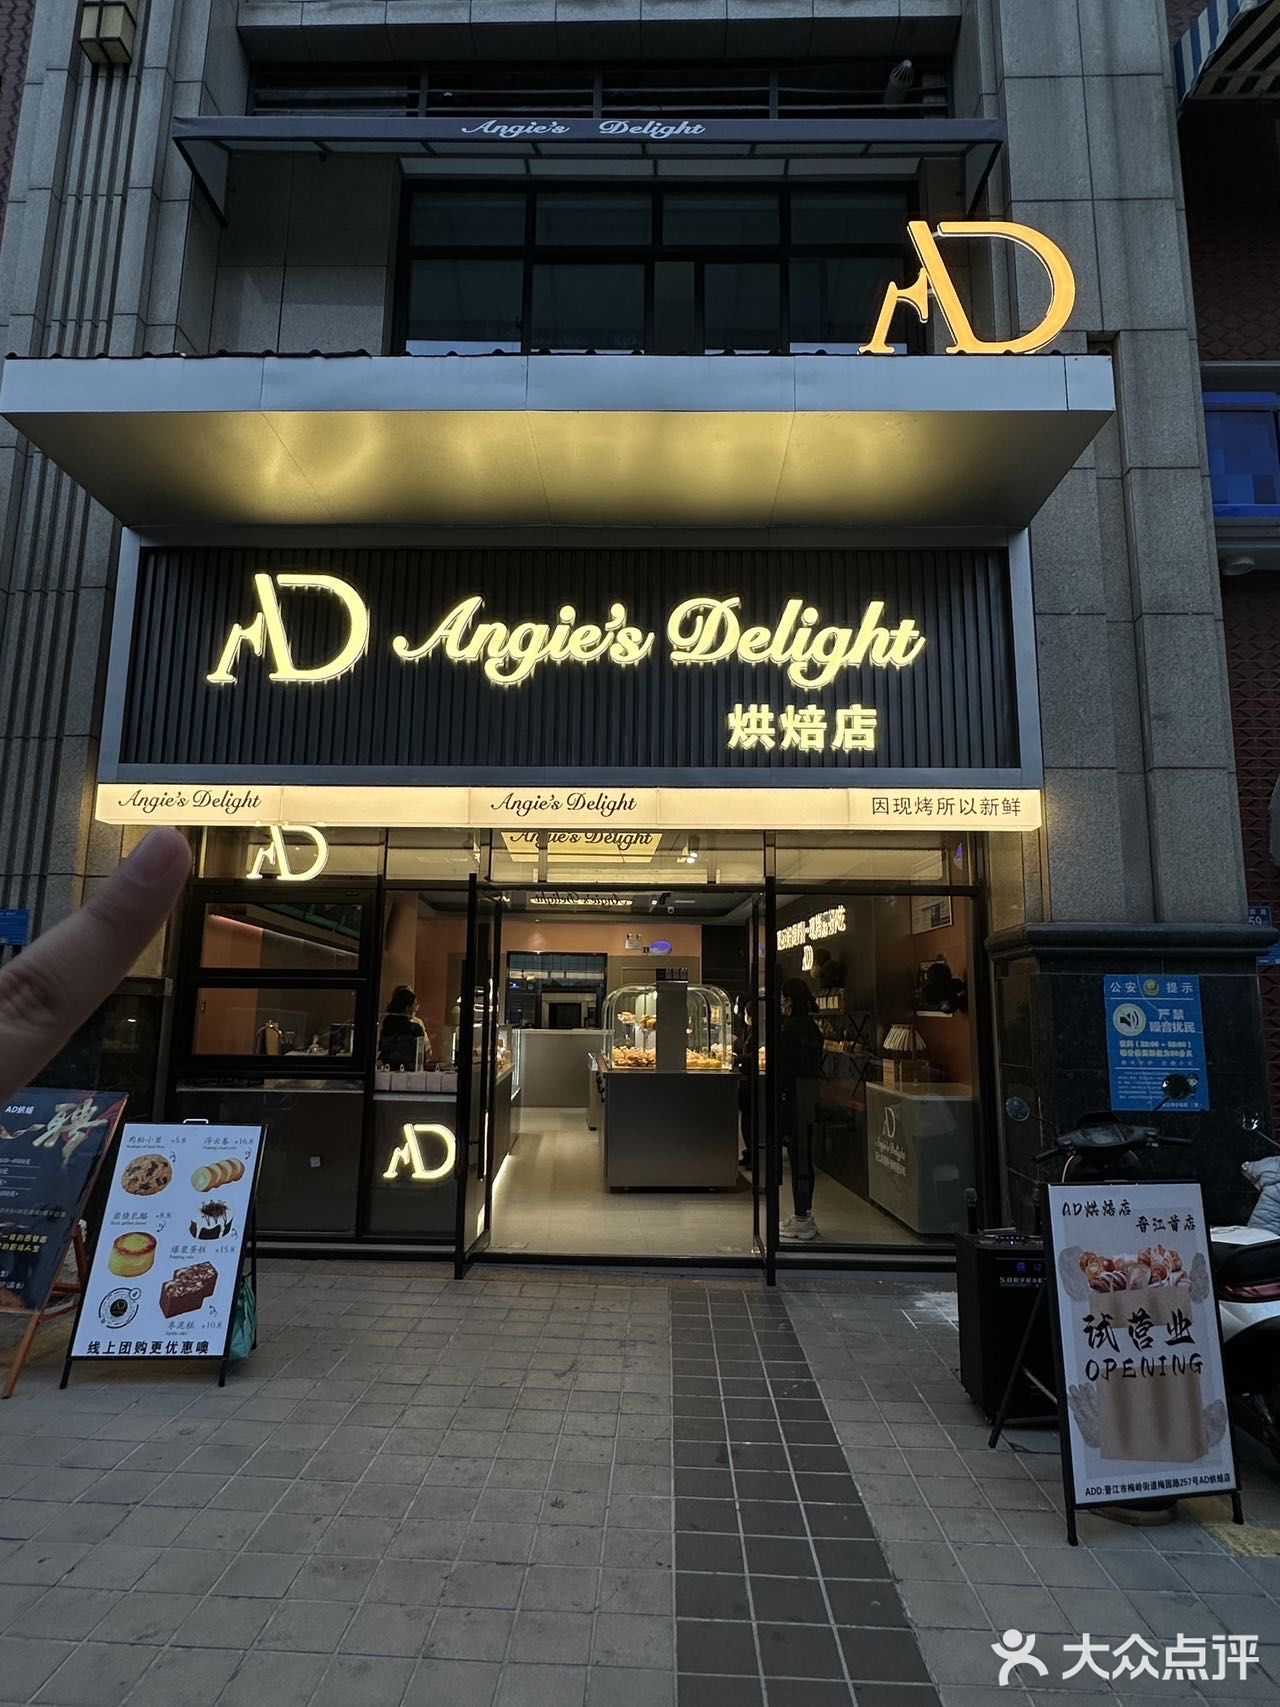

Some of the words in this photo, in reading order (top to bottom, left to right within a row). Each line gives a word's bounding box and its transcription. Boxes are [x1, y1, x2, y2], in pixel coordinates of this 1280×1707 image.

[461, 119, 570, 138] Angie's
[598, 120, 706, 139] Delight
[858, 219, 1077, 355] AD
[206, 573, 369, 682] AD
[392, 595, 655, 686] Angie's
[667, 597, 927, 690] Delight
[727, 703, 878, 750] 烘焙店
[118, 789, 190, 814] Angie's
[192, 789, 263, 815] Delight
[491, 792, 564, 817] Angie's
[567, 792, 637, 818] Delight
[871, 796, 1022, 817] 因现烤所以新鲜
[246, 825, 329, 881] AD
[1110, 982, 1137, 993] 公安
[1166, 982, 1193, 994] 提示
[383, 1123, 457, 1180] AD
[1136, 1215, 1196, 1233] 晋江首店
[1082, 1307, 1196, 1353] 试营业
[1085, 1352, 1204, 1382] OPENING
